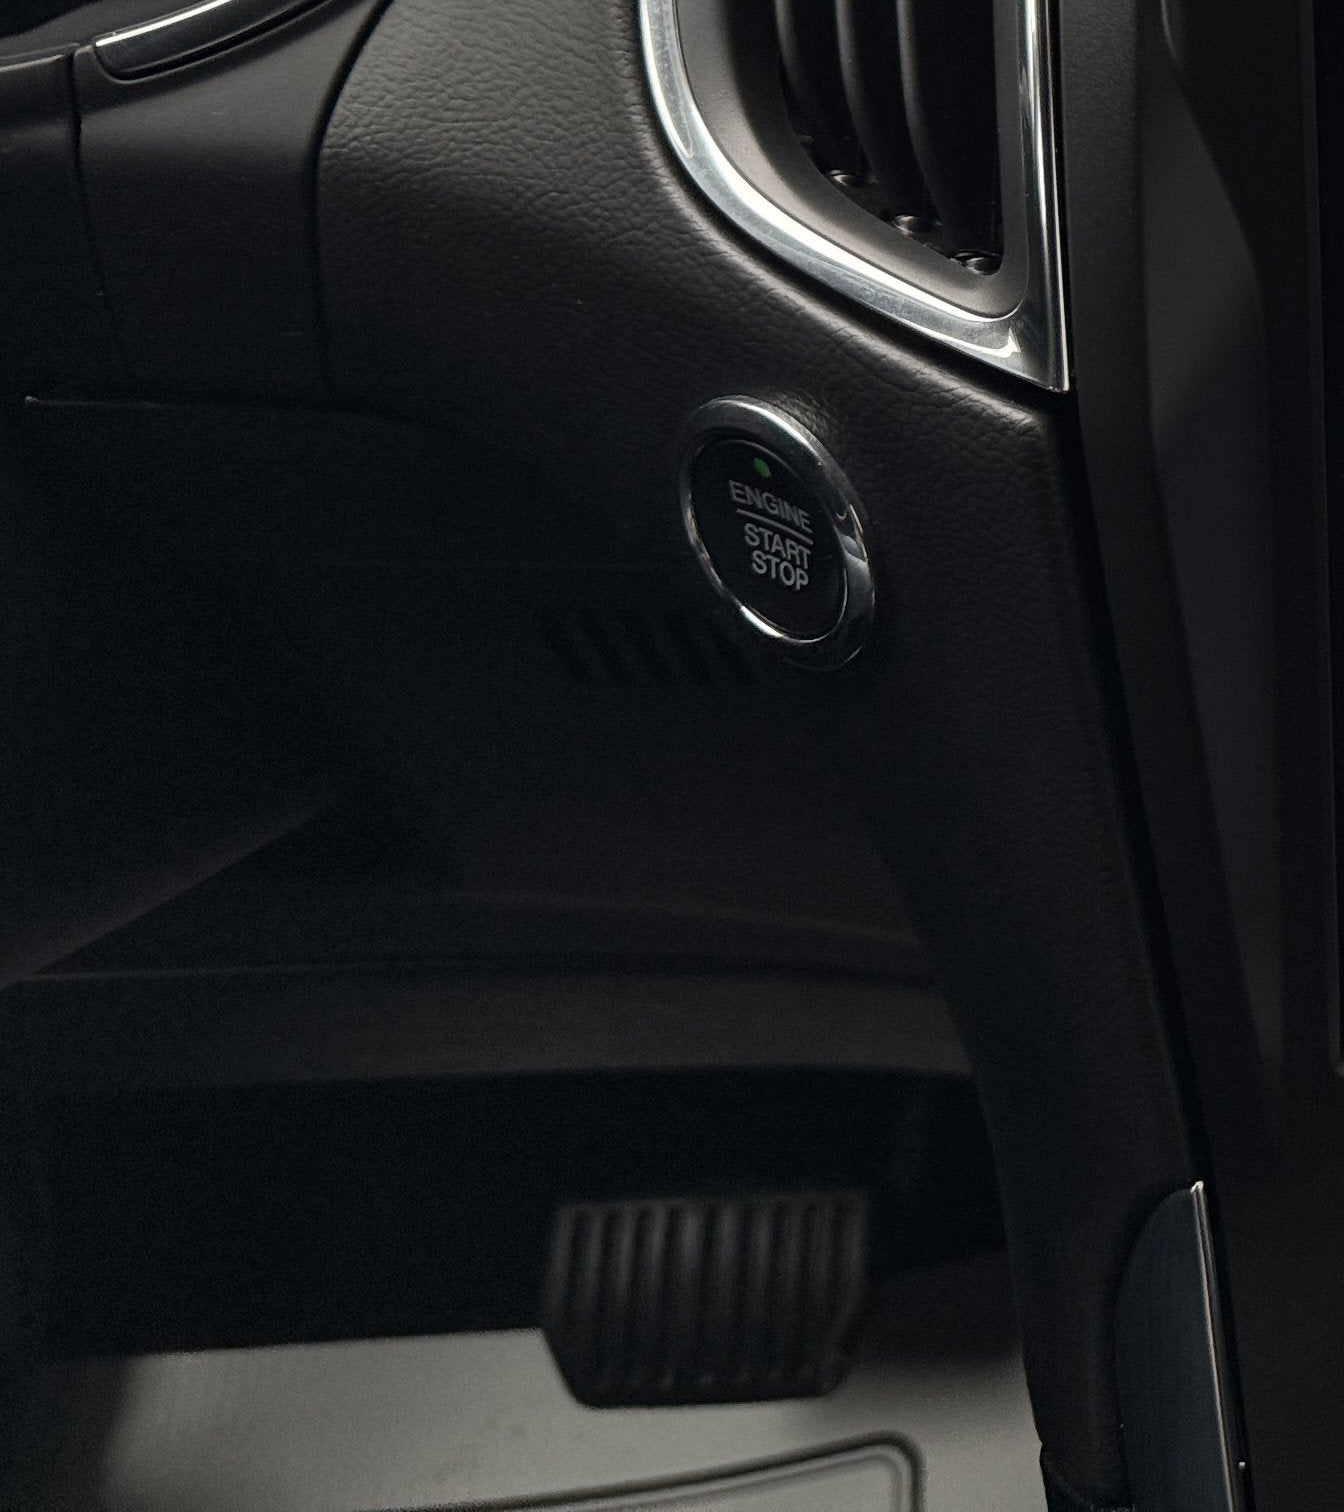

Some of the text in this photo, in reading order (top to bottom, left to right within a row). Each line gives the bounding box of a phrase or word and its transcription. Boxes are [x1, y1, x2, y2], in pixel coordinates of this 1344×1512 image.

[728, 479, 813, 535] ENGINE
[744, 522, 811, 570] START
[752, 550, 809, 591] STOP
